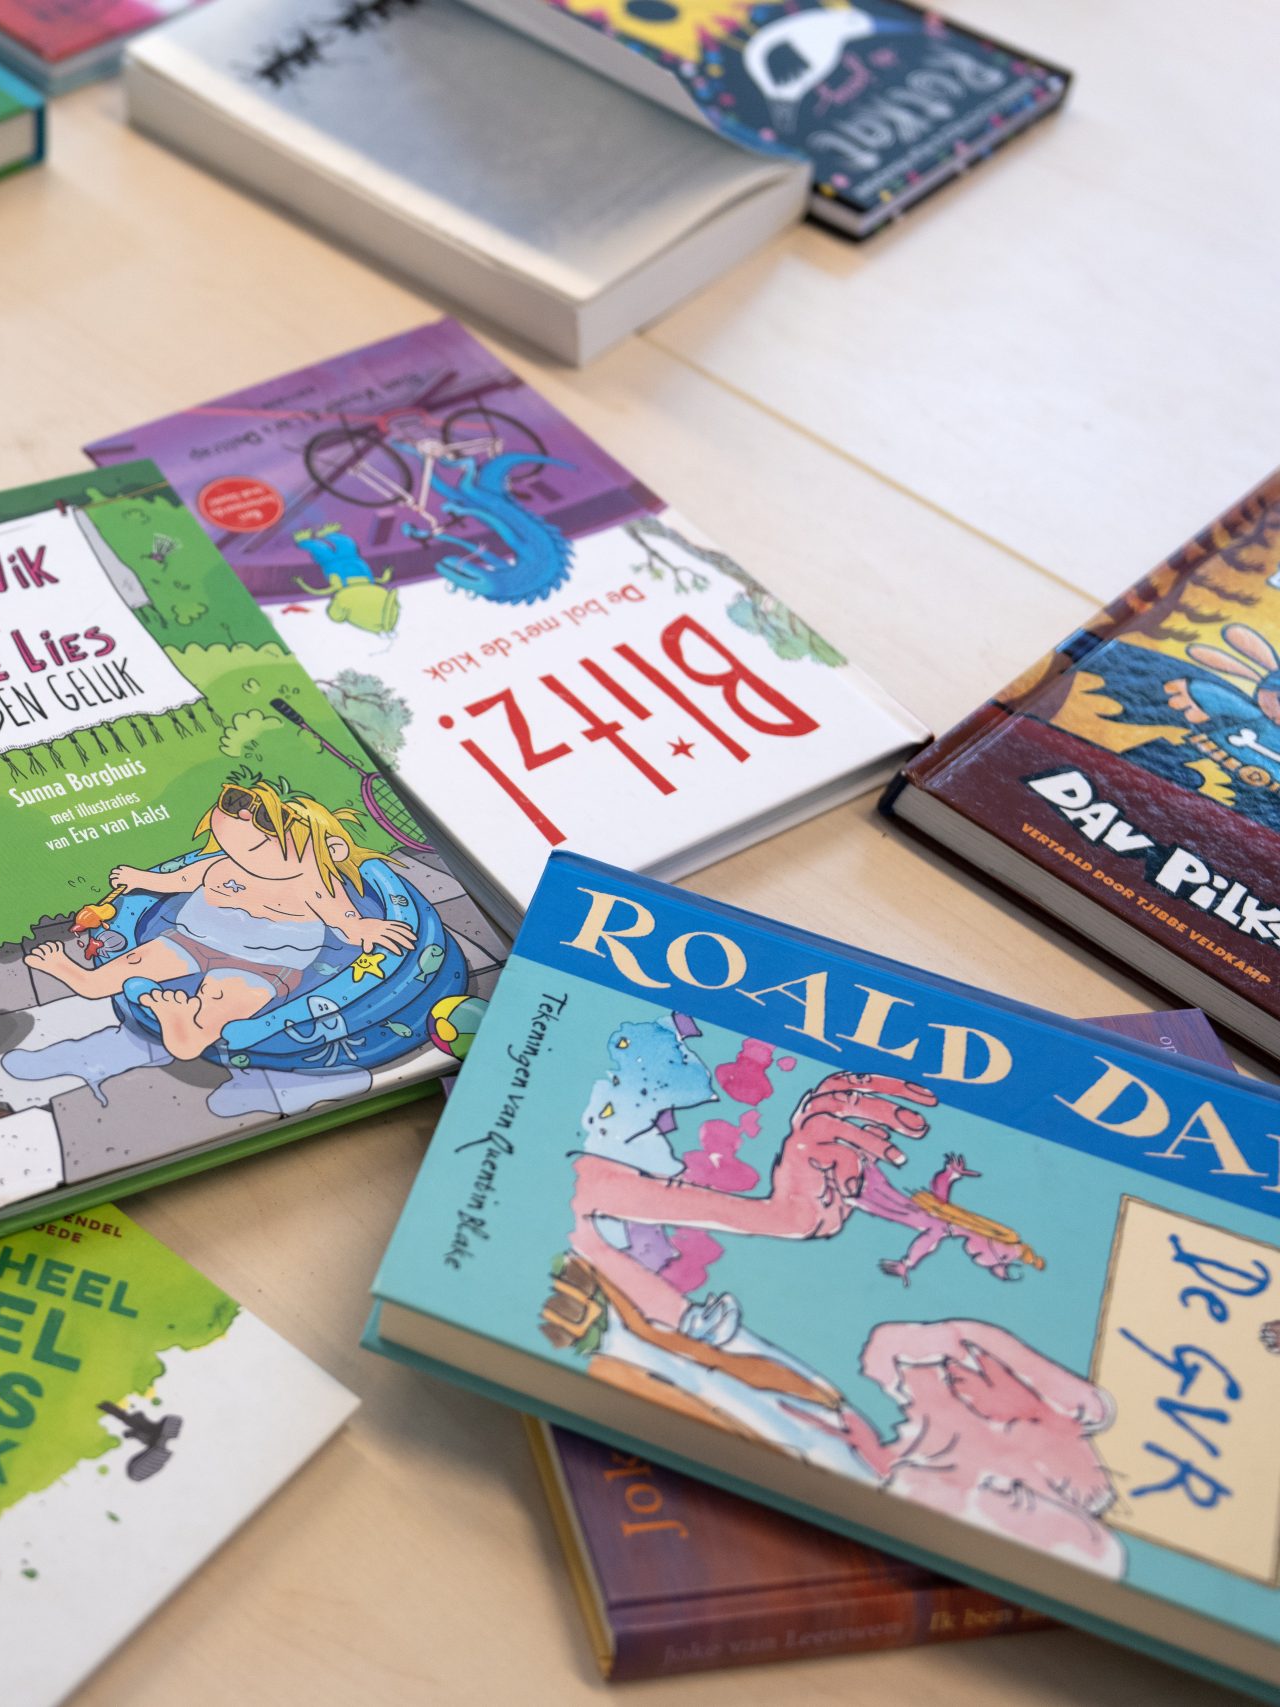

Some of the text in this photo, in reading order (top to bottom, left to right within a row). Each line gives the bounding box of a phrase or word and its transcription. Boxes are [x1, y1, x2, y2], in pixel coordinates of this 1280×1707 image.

[422, 583, 646, 683] De bol met de klok
[47, 657, 144, 714] GELUK
[9, 758, 147, 808] Sunna Borghuis
[50, 791, 141, 826] met illustraties
[1028, 771, 1155, 852] DAV
[45, 804, 170, 851] van Eva van Aalst
[1022, 822, 1272, 985] VERTAALD DOOR TJIBBE VELDKAMP
[560, 887, 1014, 1088] ROALD
[444, 993, 568, 1270] Tekeningen van Quentin Blake
[32, 1222, 83, 1244] OEDE
[64, 1211, 123, 1238] ENDEL
[1167, 1232, 1273, 1326] De
[1114, 1324, 1245, 1510] GVR
[601, 1449, 690, 1543] Jok
